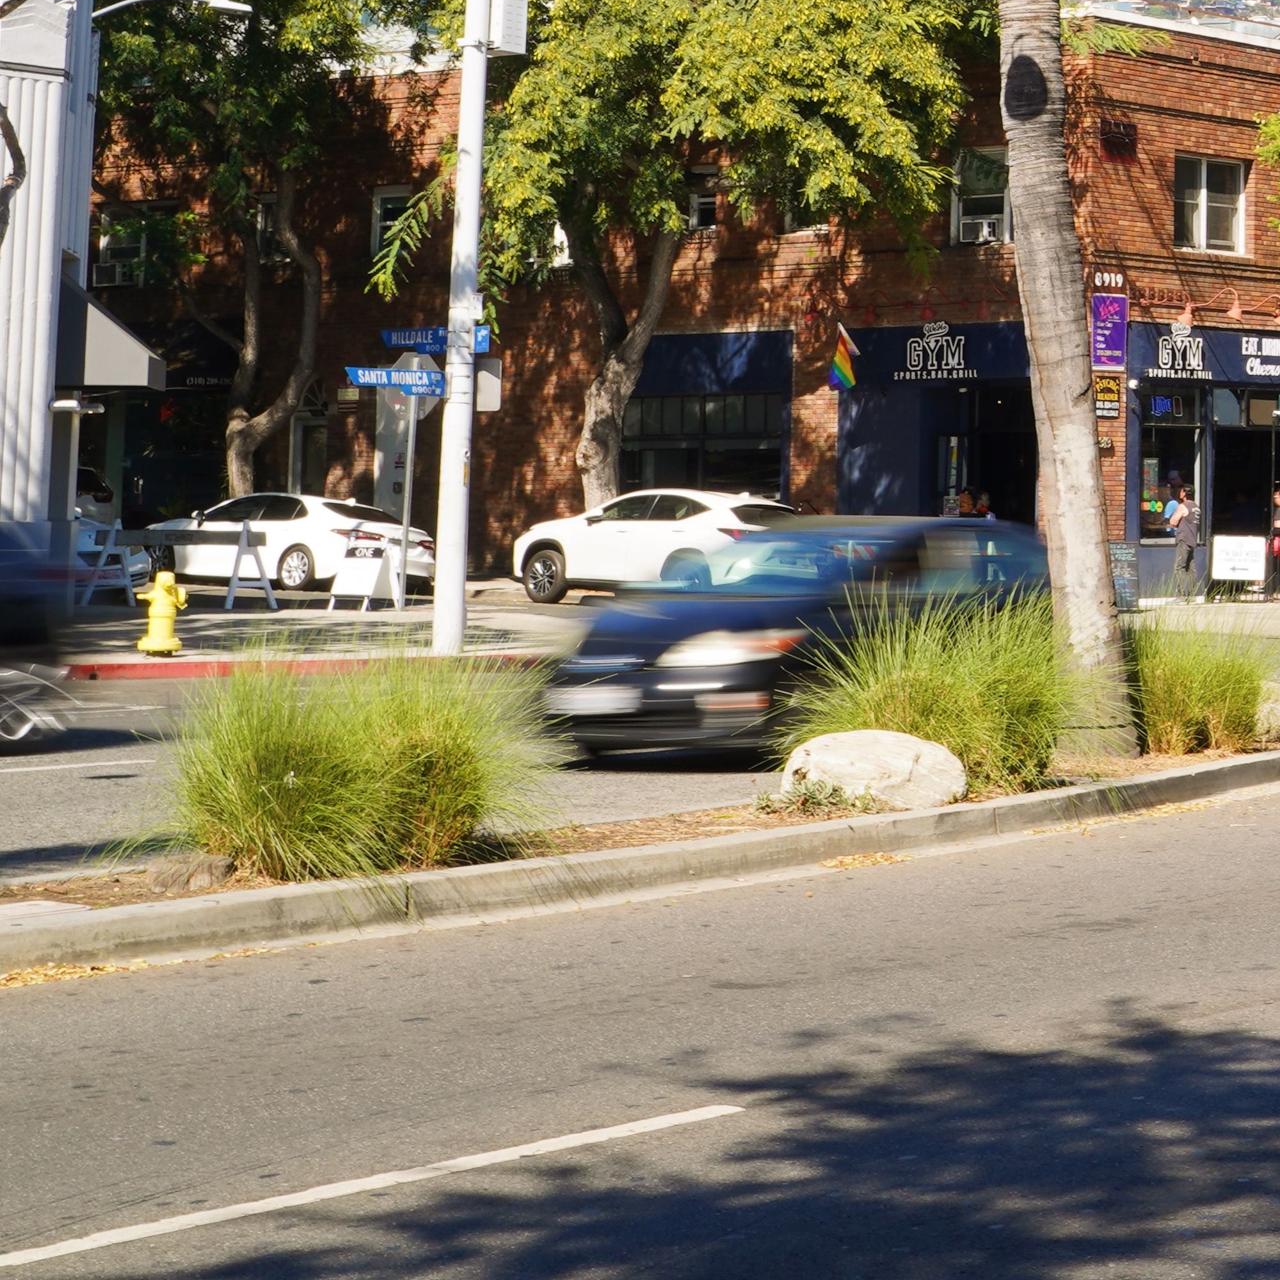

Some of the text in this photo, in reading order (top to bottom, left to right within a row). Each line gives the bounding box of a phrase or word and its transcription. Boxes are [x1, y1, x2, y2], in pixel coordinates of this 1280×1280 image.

[1094, 272, 1123, 287] 8919
[391, 330, 433, 345] HILLDALE
[425, 344, 440, 352] 800
[907, 336, 965, 370] GYM
[1158, 336, 1203, 370] GYM
[358, 370, 388, 385] SANTA
[391, 371, 429, 385] MONICA
[411, 386, 432, 394] 8900
